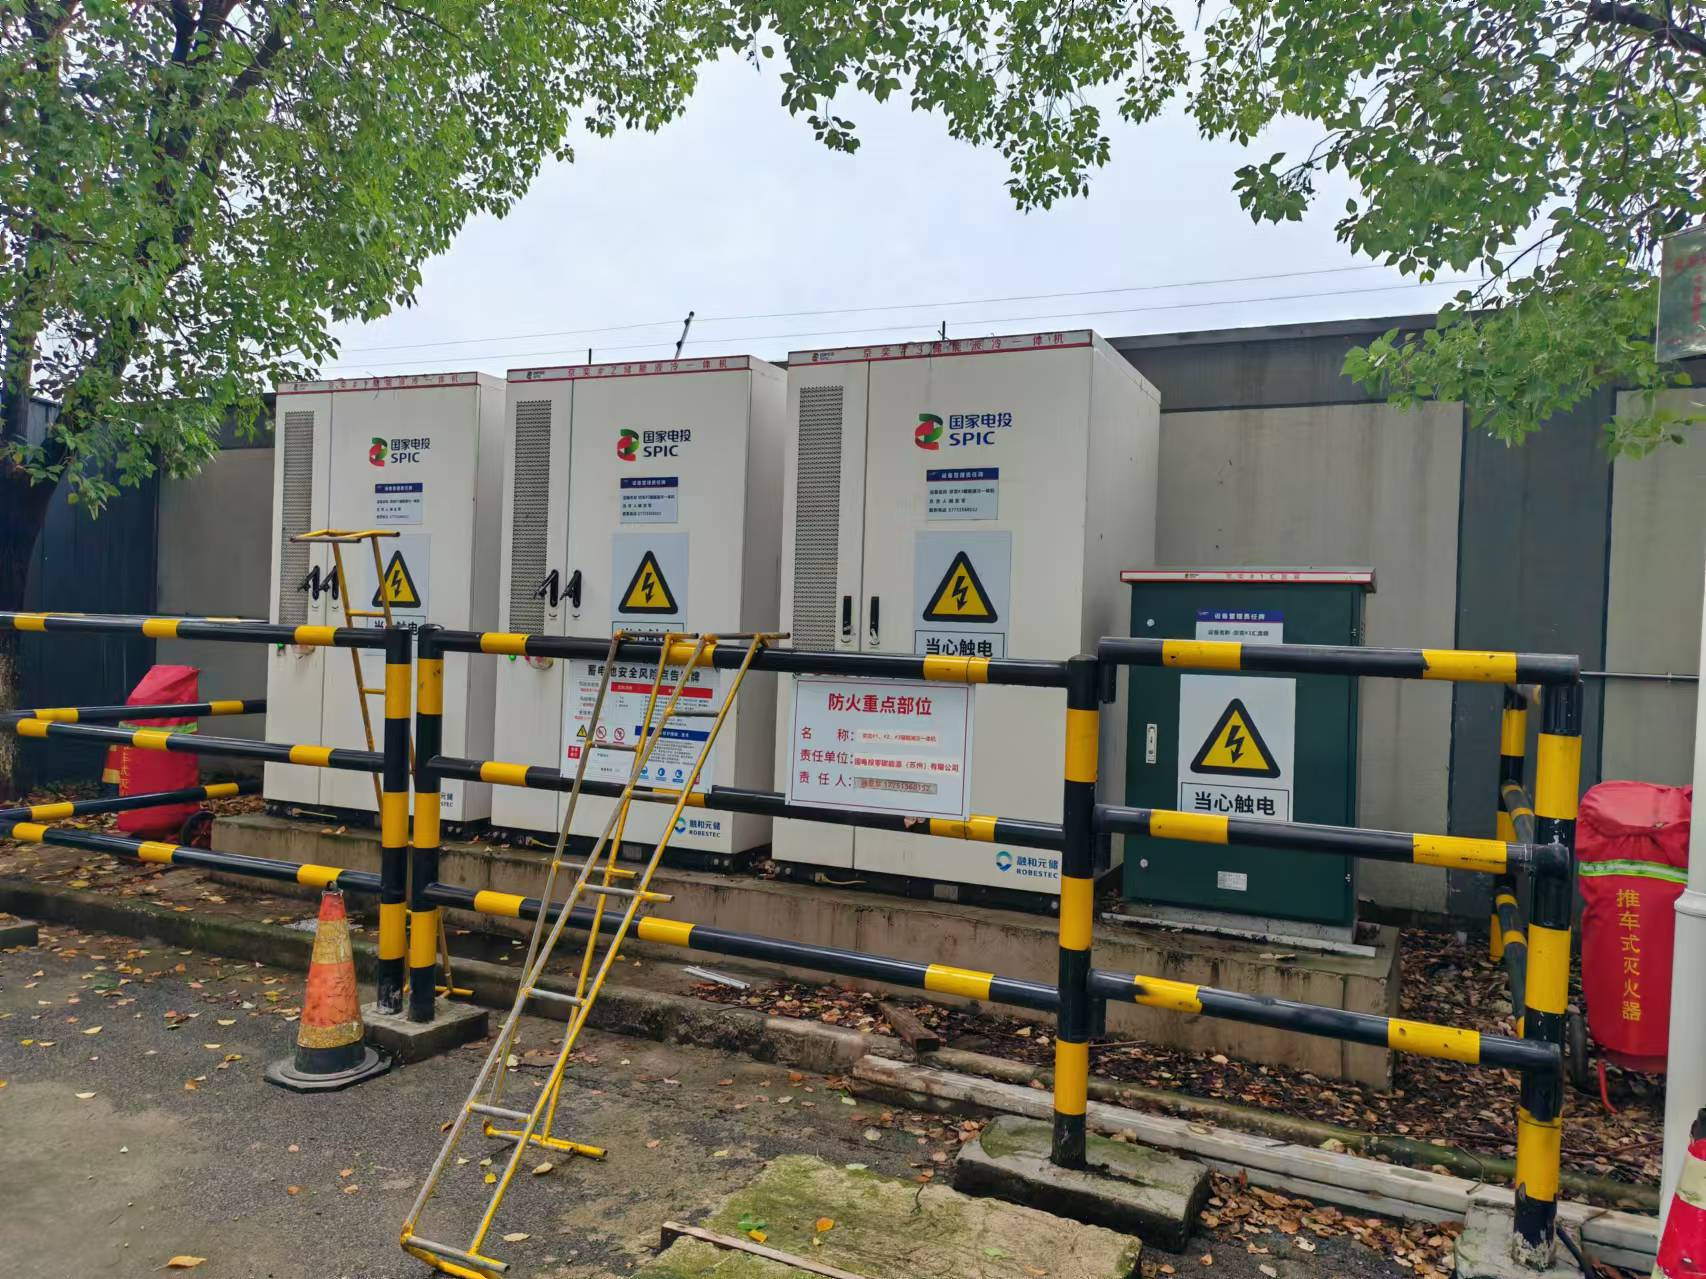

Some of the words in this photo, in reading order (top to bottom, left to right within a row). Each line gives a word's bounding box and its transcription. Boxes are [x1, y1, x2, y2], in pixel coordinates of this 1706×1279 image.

[949, 412, 1012, 429] 国家电投
[643, 429, 691, 444] 国家电投
[949, 431, 995, 446] SPIC
[391, 438, 431, 451] 国家电投
[643, 445, 679, 457] SPIC
[391, 452, 420, 464] SPIC
[926, 637, 993, 657] 当心触电
[828, 693, 933, 716] 防火重点部位
[1194, 791, 1275, 816] 当心触电
[689, 830, 721, 838] ROBESTEC
[1016, 856, 1058, 869] 融和元储
[1016, 868, 1058, 879] ROBESTEC
[1616, 888, 1641, 1021] 推车式灭火器
